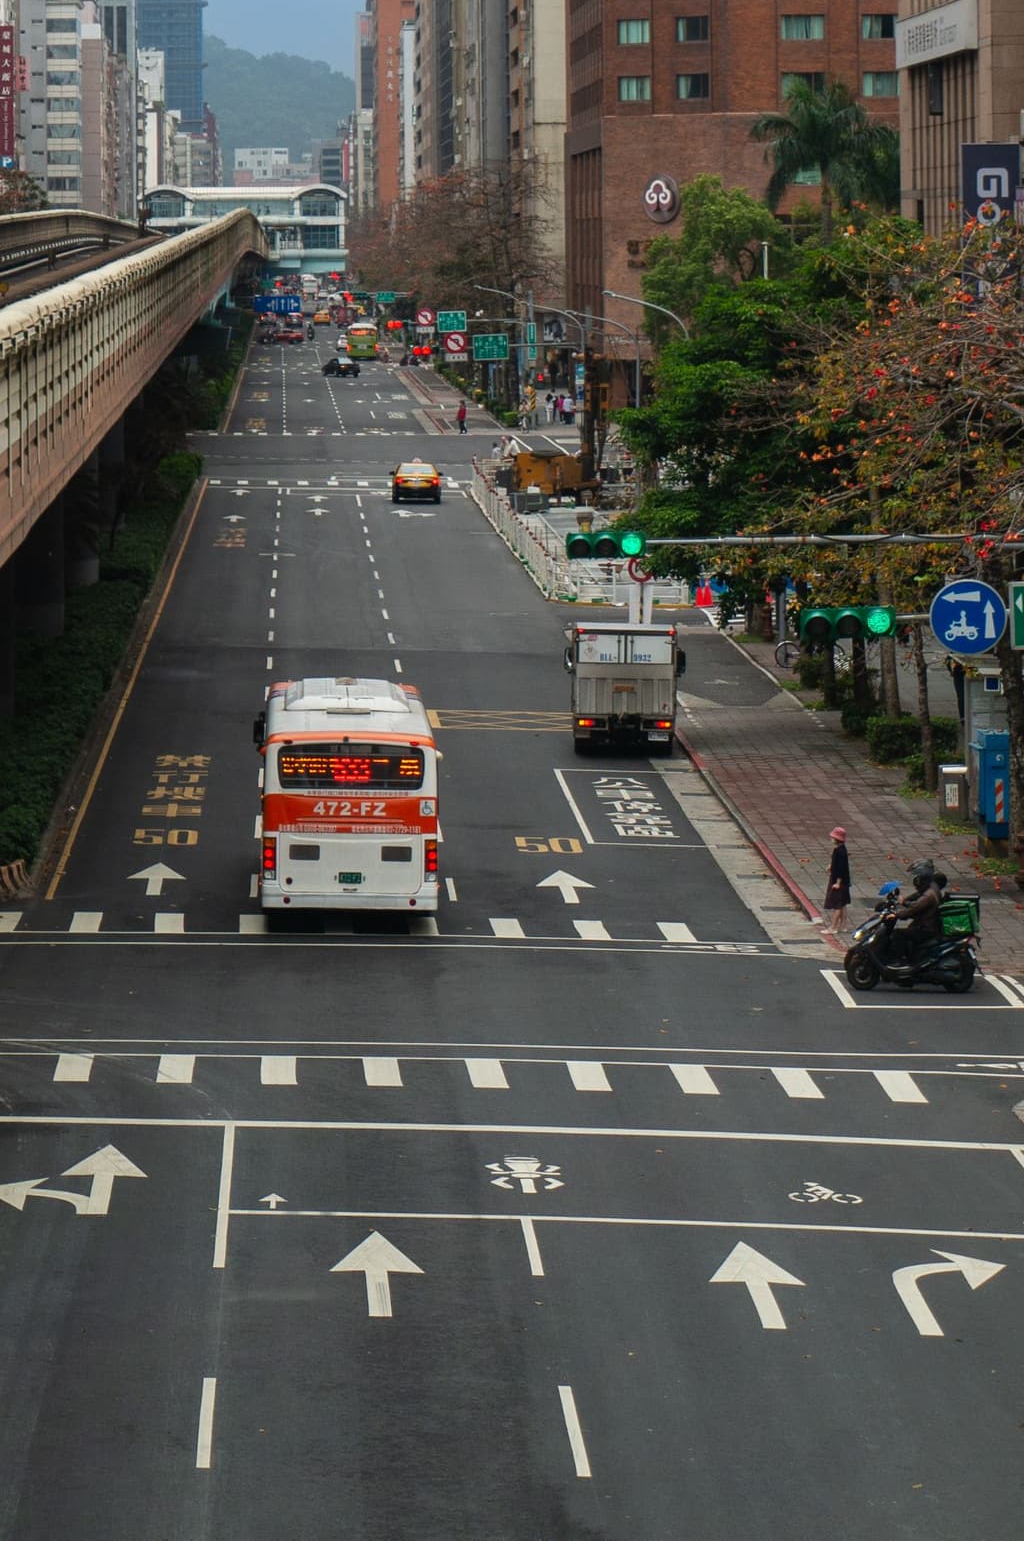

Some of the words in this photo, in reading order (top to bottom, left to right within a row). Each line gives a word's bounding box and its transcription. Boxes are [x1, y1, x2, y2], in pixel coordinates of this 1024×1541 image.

[141, 754, 212, 817] 禁行機車
[313, 802, 386, 816] 472-FZ
[133, 828, 199, 845] 50
[515, 836, 584, 853] 50
